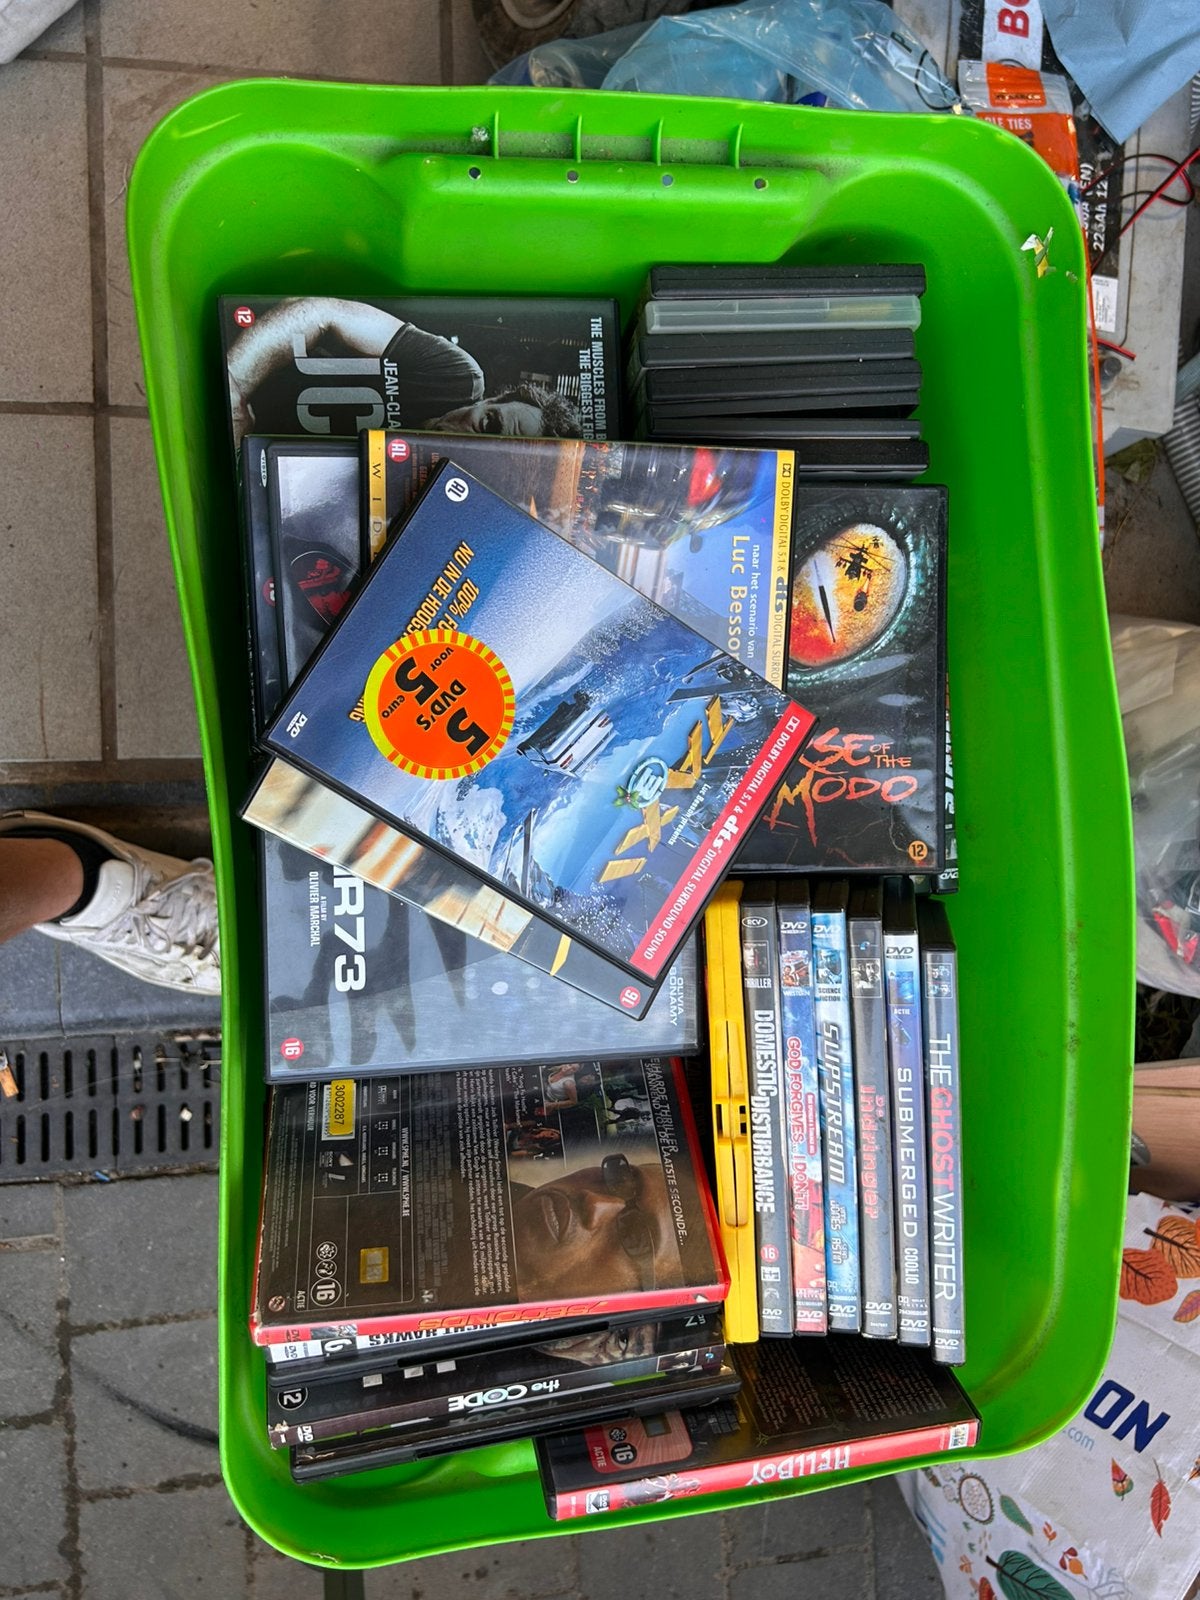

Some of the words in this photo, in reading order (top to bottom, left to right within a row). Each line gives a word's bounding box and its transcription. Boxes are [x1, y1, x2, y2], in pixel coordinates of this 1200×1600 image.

[997, 0, 1030, 38] B
[1006, 117, 1032, 130] TIES
[1095, 179, 1108, 198] 12
[1091, 202, 1108, 251] 225Ah
[237, 310, 250, 323] 12
[590, 317, 601, 338] THE
[578, 349, 590, 369] THE
[590, 340, 603, 388] MUSCLES
[292, 334, 383, 433] JC
[579, 373, 590, 420] BIGGEST
[592, 391, 604, 429] FROM
[391, 443, 406, 457] AL
[446, 480, 466, 500] AL
[780, 481, 790, 513] DOLBY
[777, 514, 787, 548] DIGITAL
[450, 540, 476, 569] NU
[730, 535, 749, 575] Luc
[751, 544, 760, 569] naar
[777, 551, 785, 565] 5.1
[441, 560, 464, 583] IN
[750, 572, 760, 590] het
[430, 575, 454, 600] DE
[446, 577, 482, 619] 100%
[774, 576, 787, 613] dts
[403, 591, 444, 641] HOOGS
[748, 593, 759, 636] scenario
[772, 614, 783, 647] DIGITAL
[430, 647, 454, 671] voor
[746, 640, 756, 658] van
[771, 649, 781, 685] SURROU
[395, 656, 440, 706] 5
[381, 694, 405, 718] euro
[288, 713, 309, 738] DVD
[446, 707, 490, 756] 5
[764, 730, 792, 763] DOLBY
[801, 727, 875, 773] SE
[869, 742, 894, 753] OF
[874, 754, 912, 768] THE
[698, 782, 711, 796] Luc
[744, 759, 774, 796] DIGITAL
[684, 793, 704, 819] Besson
[732, 804, 745, 817] &
[737, 791, 754, 809] 5.1
[666, 816, 688, 846] presents
[710, 812, 743, 852] dts
[911, 844, 924, 856] 12
[688, 847, 719, 884] DIGITAL
[308, 871, 319, 903] OLIVIER
[659, 880, 699, 930] SURROUND
[309, 905, 320, 946] MARCHAL
[333, 865, 366, 992] R73
[780, 921, 807, 930] DVD
[813, 925, 841, 933] DVD
[640, 926, 669, 961] SOUND
[886, 946, 914, 955] DVD
[745, 977, 772, 988] THRILLER
[621, 989, 639, 1006] 16
[669, 966, 677, 1027] BONAMY
[284, 1040, 300, 1057] 16
[754, 1009, 777, 1096] DOMESTIC
[787, 1036, 802, 1070] GOD
[929, 1033, 952, 1087] THE
[308, 1090, 316, 1104] VOOR
[644, 1061, 661, 1110] SPANNEND
[334, 1084, 345, 1124] 3002287
[823, 1022, 845, 1184] SLIPSTREAM
[307, 1106, 315, 1130] VERHUUR
[653, 1111, 665, 1128] TOT
[659, 1103, 678, 1153] THRILLER
[657, 1130, 669, 1144] DE
[930, 1087, 955, 1191] GHOST
[660, 1144, 676, 1185] LAATSTE
[751, 1096, 776, 1212] DISTURBANCE
[897, 1067, 918, 1238] SUBMERGED
[668, 1187, 688, 1246] SECONDE...
[830, 1200, 840, 1231] JONES
[763, 1247, 776, 1259] 16
[832, 1237, 843, 1264] ASTIN
[933, 1192, 956, 1300] WRITER
[904, 1247, 919, 1285] COOLIO
[296, 1290, 305, 1308] ACTIE
[316, 1282, 335, 1300] 16
[418, 1302, 588, 1330] SECONDS
[762, 1308, 782, 1316] DVD
[796, 1310, 823, 1318] DVD
[829, 1304, 856, 1314] DVD
[865, 1301, 892, 1311] DVD
[900, 1318, 927, 1328] DVD
[934, 1337, 960, 1347] DVD
[446, 1383, 528, 1411] CODE
[530, 1379, 560, 1394] the
[1084, 1379, 1171, 1453] ON
[303, 1426, 313, 1442] DVD
[1062, 1427, 1095, 1451] .com
[593, 1446, 607, 1468] ACTIE
[614, 1444, 634, 1462] 16
